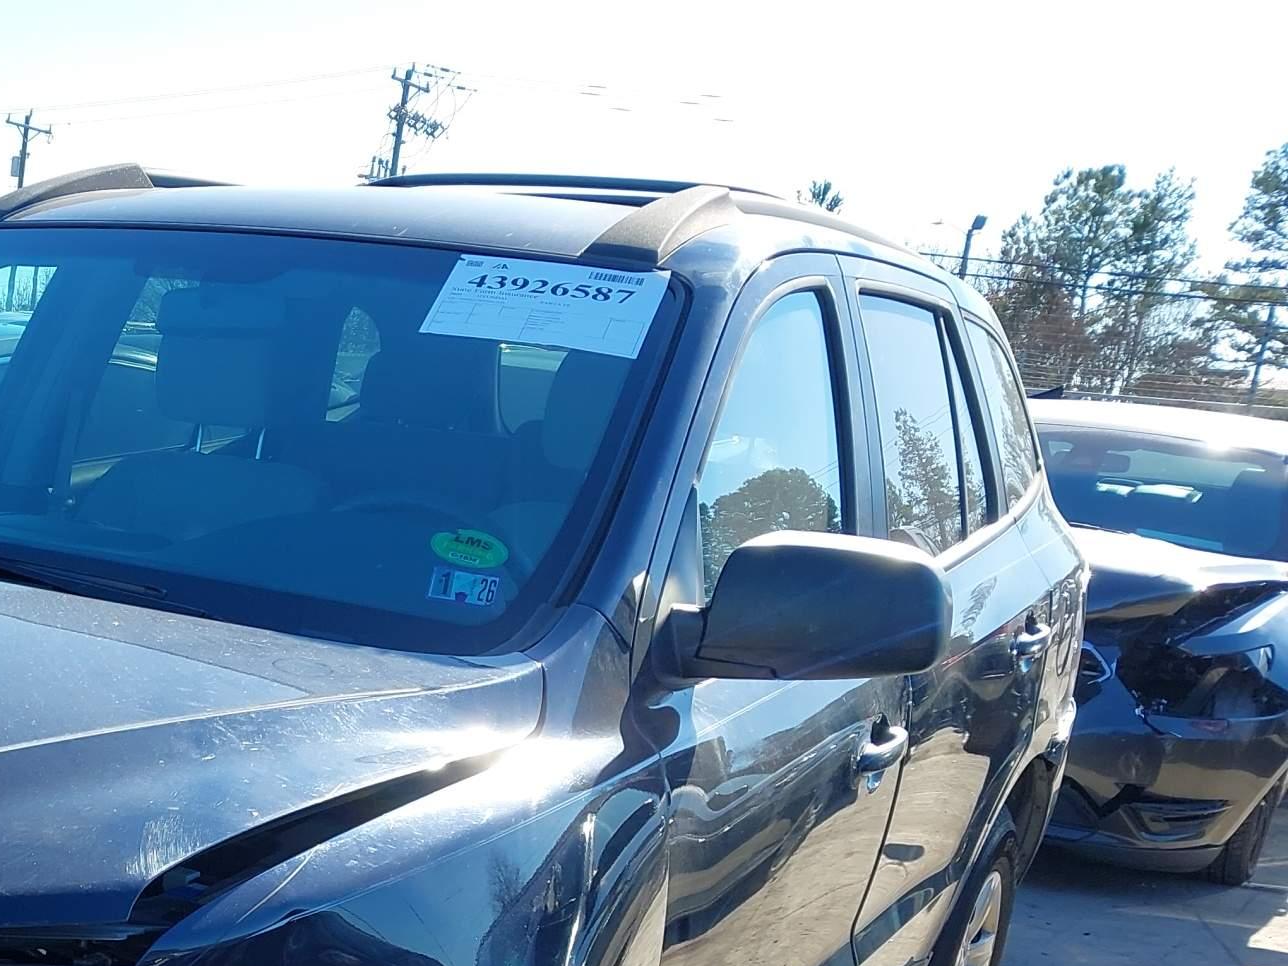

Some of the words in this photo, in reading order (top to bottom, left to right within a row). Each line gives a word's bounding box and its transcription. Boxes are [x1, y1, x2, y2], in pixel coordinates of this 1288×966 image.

[467, 273, 637, 305] 43926587
[438, 571, 452, 596] 1
[477, 578, 498, 603] 26
